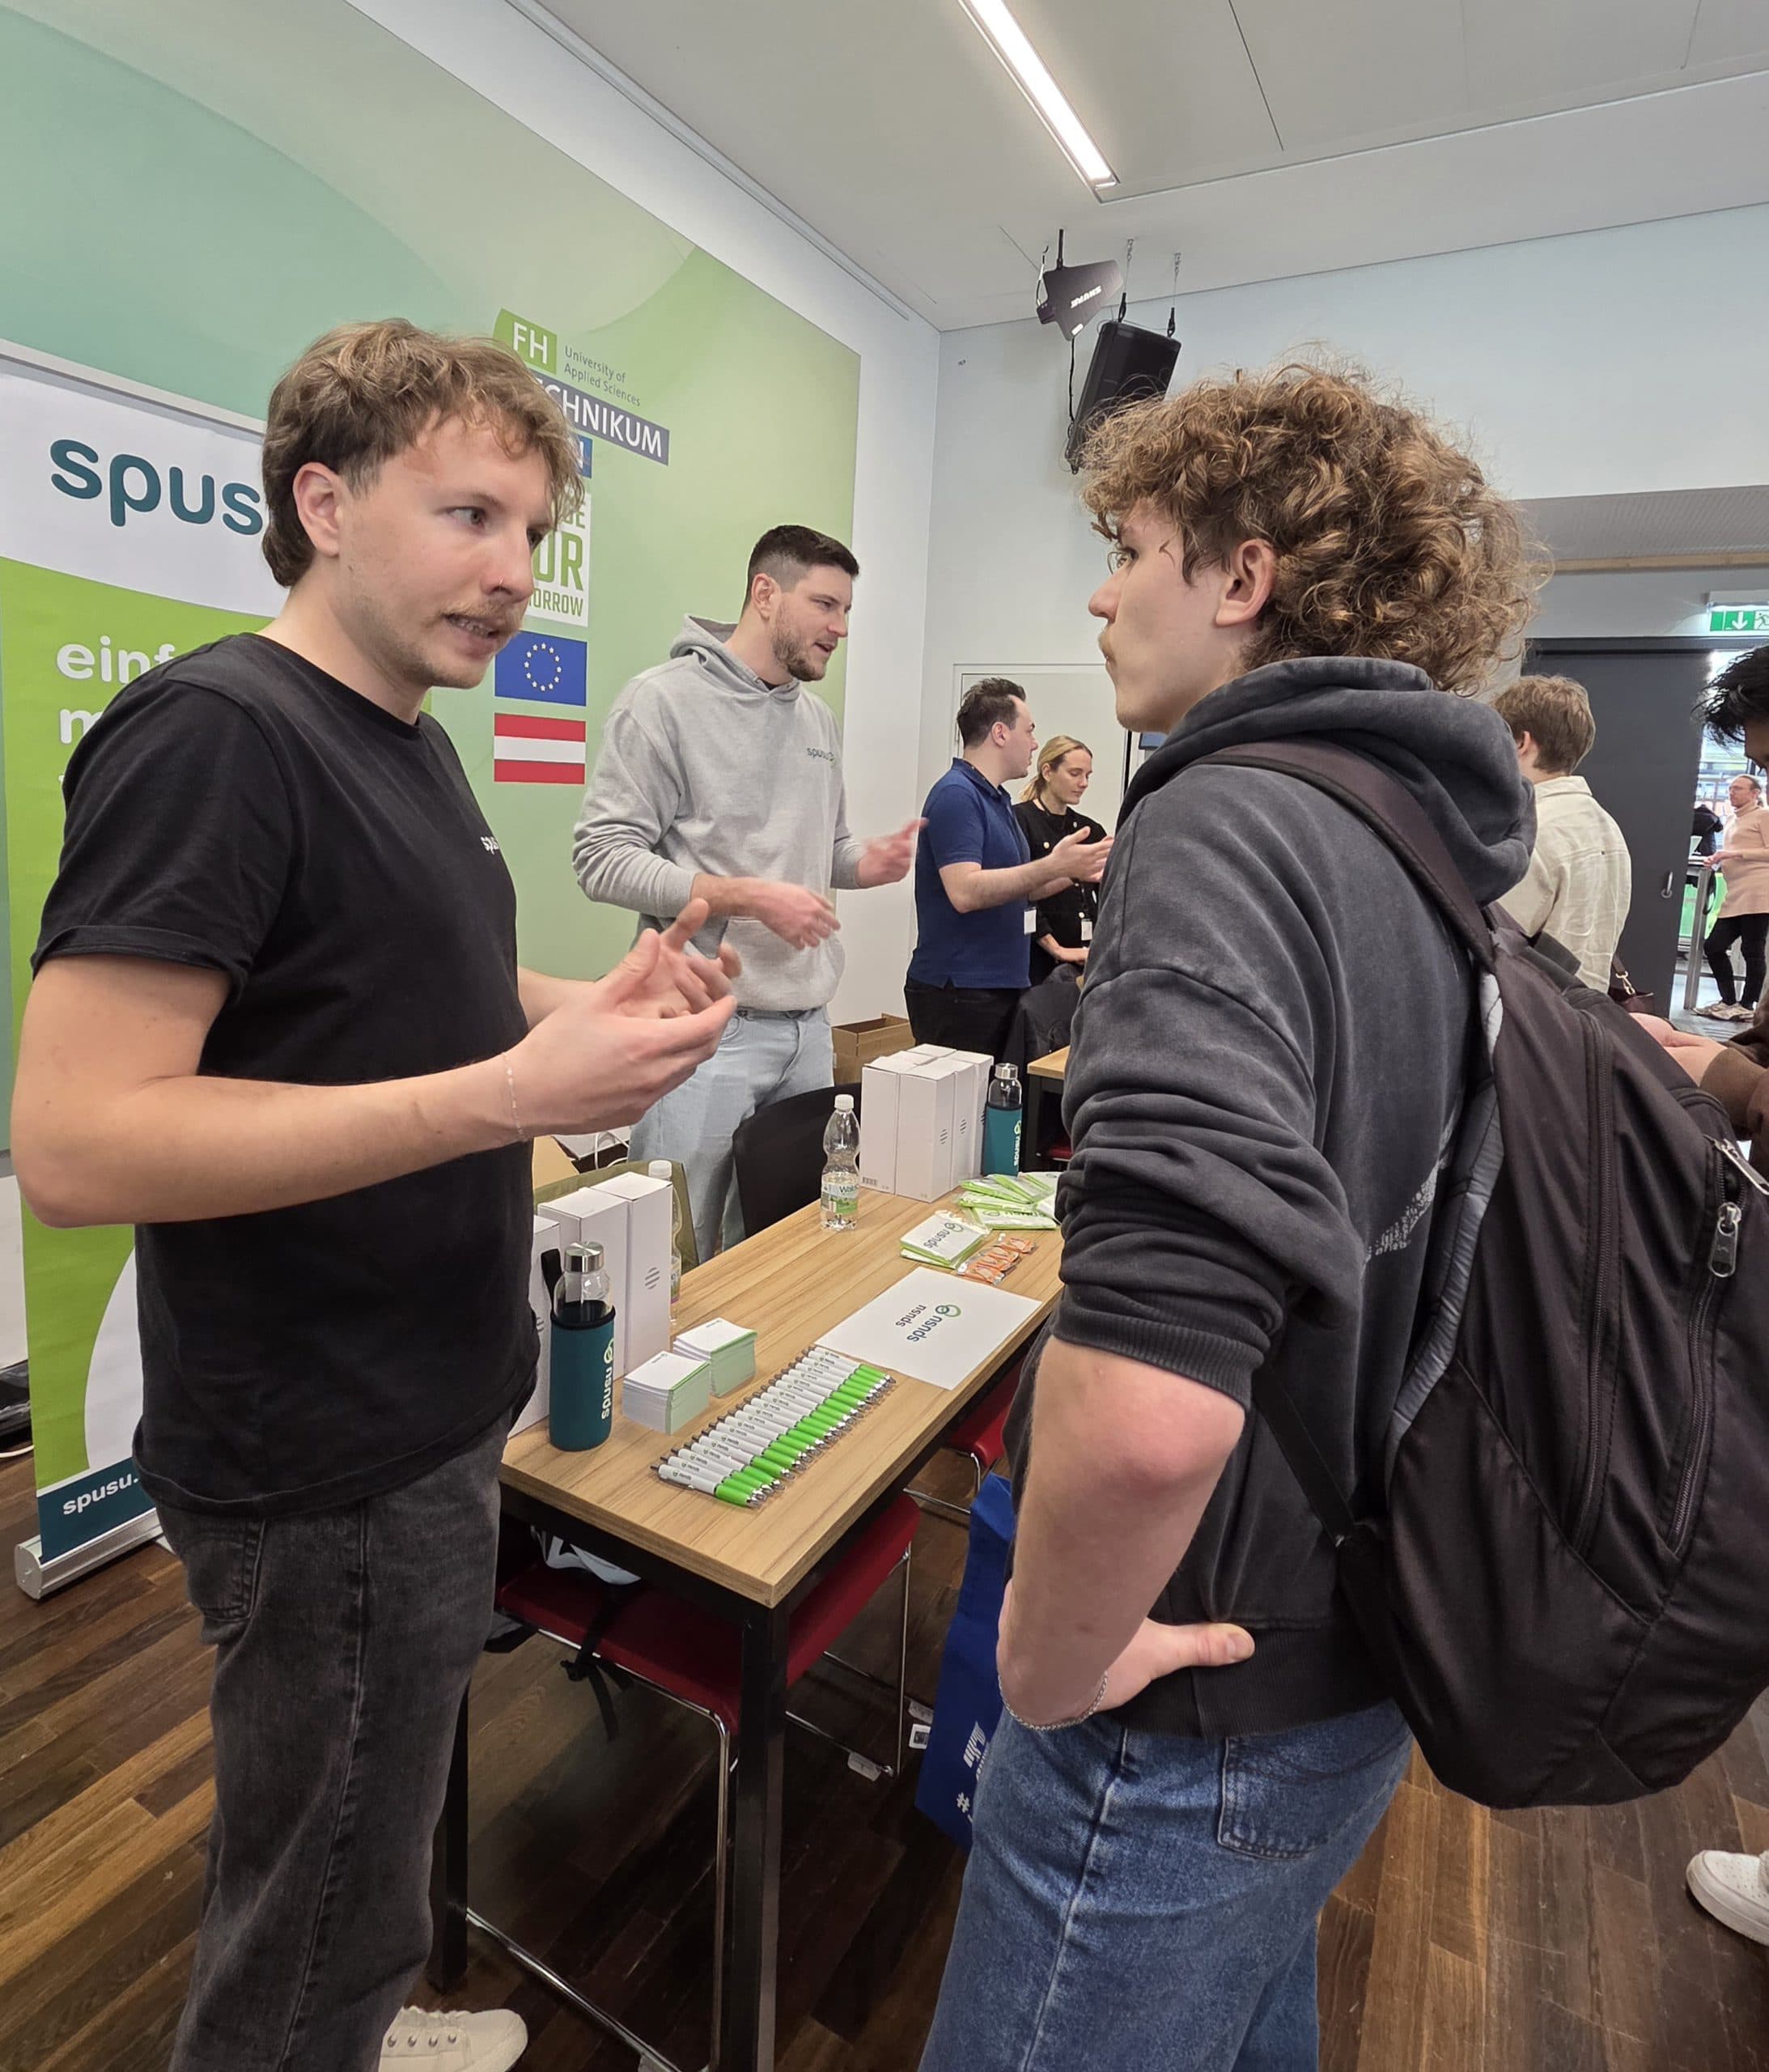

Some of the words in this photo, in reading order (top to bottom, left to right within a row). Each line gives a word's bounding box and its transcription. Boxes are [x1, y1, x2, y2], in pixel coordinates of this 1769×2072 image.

[512, 321, 548, 364] FH
[564, 346, 613, 380] University
[616, 372, 626, 383] of
[564, 363, 600, 388] Applied
[604, 380, 641, 406] Sciences
[529, 587, 583, 618] ORROW
[923, 1229, 951, 1249] spusu
[895, 1304, 927, 1327] spusu
[906, 1315, 943, 1343] spusu
[601, 1366, 613, 1420] spusu
